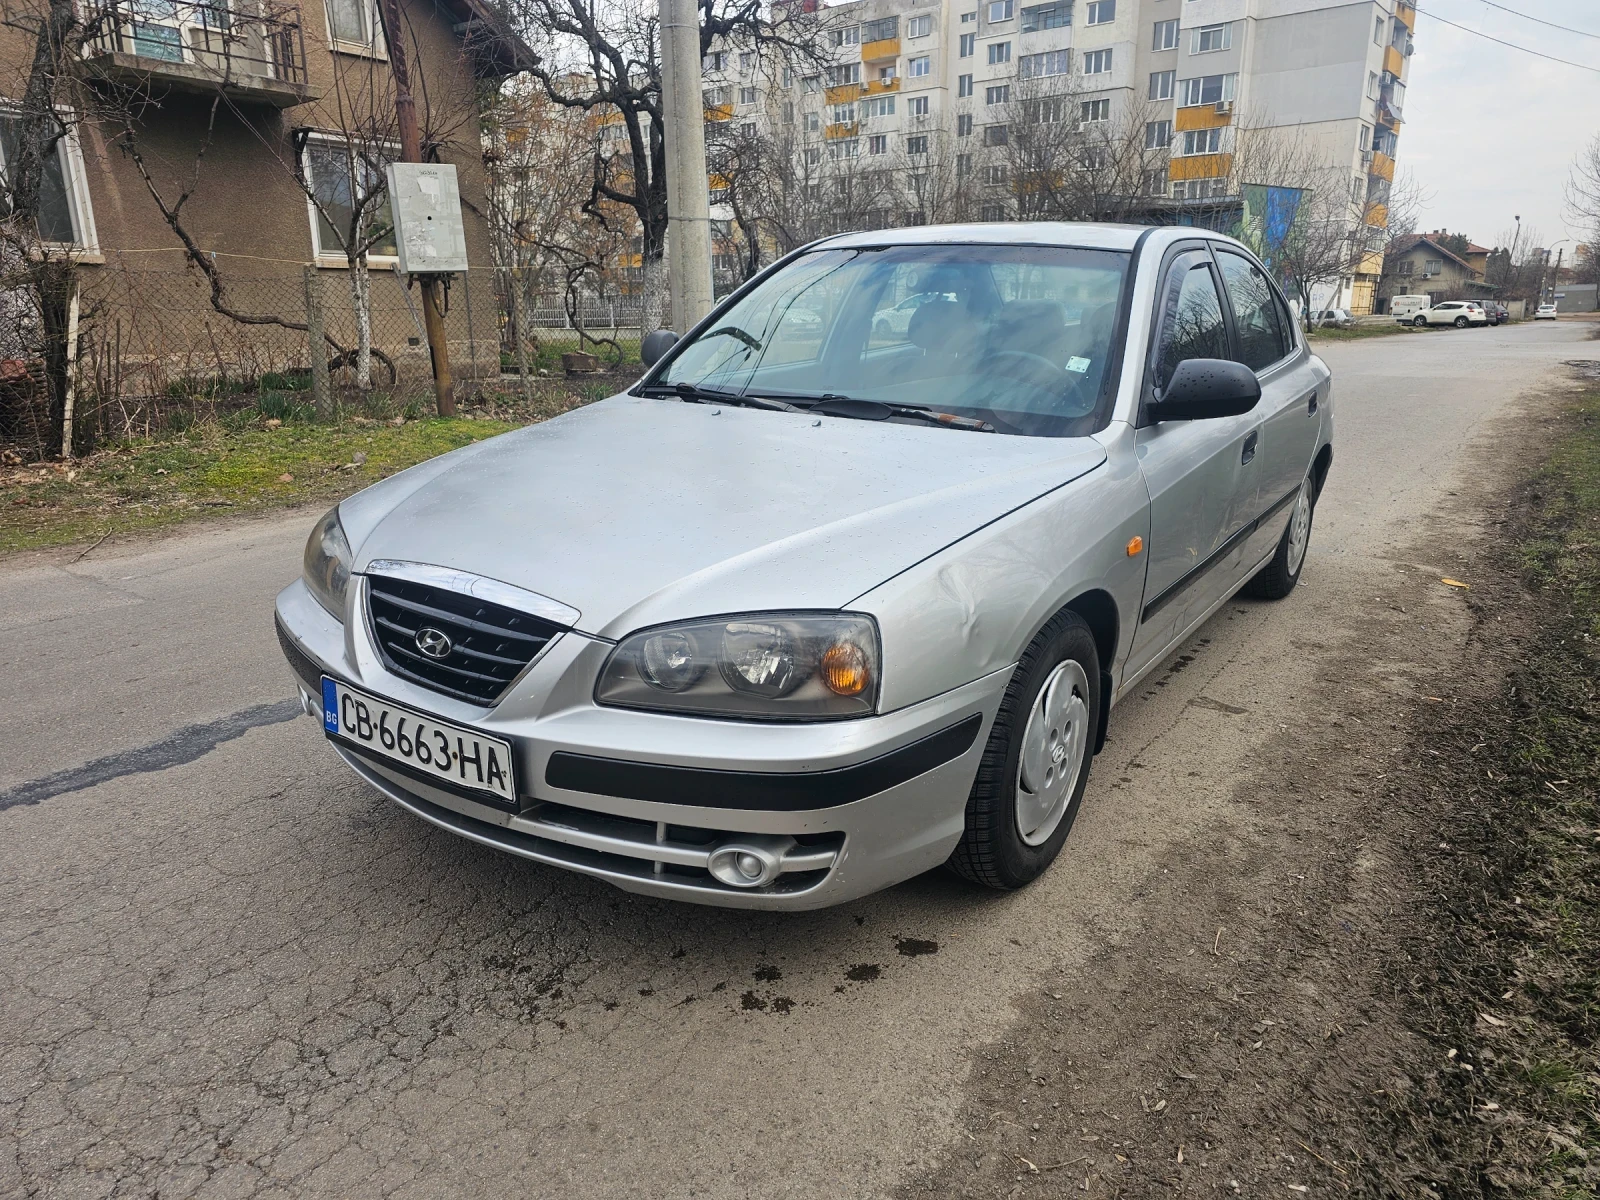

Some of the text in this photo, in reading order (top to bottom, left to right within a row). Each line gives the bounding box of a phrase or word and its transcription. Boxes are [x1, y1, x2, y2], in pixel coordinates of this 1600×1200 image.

[326, 710, 338, 725] BG
[341, 692, 506, 791] CB 6663 HA
